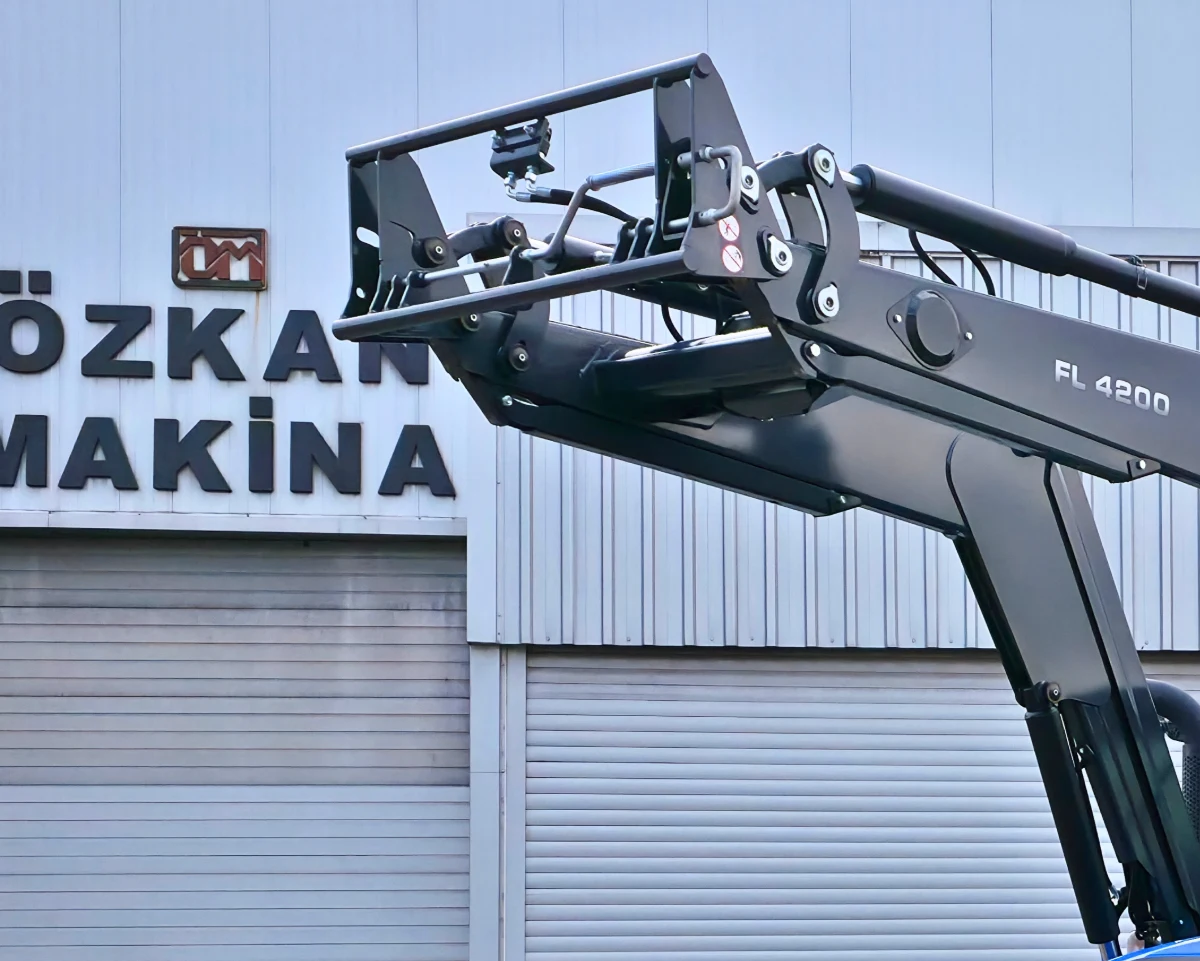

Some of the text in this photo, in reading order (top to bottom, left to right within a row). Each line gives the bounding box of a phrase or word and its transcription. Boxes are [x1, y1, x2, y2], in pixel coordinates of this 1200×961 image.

[0, 270, 429, 384] ÖZKAN
[1055, 359, 1170, 416] FL 4200
